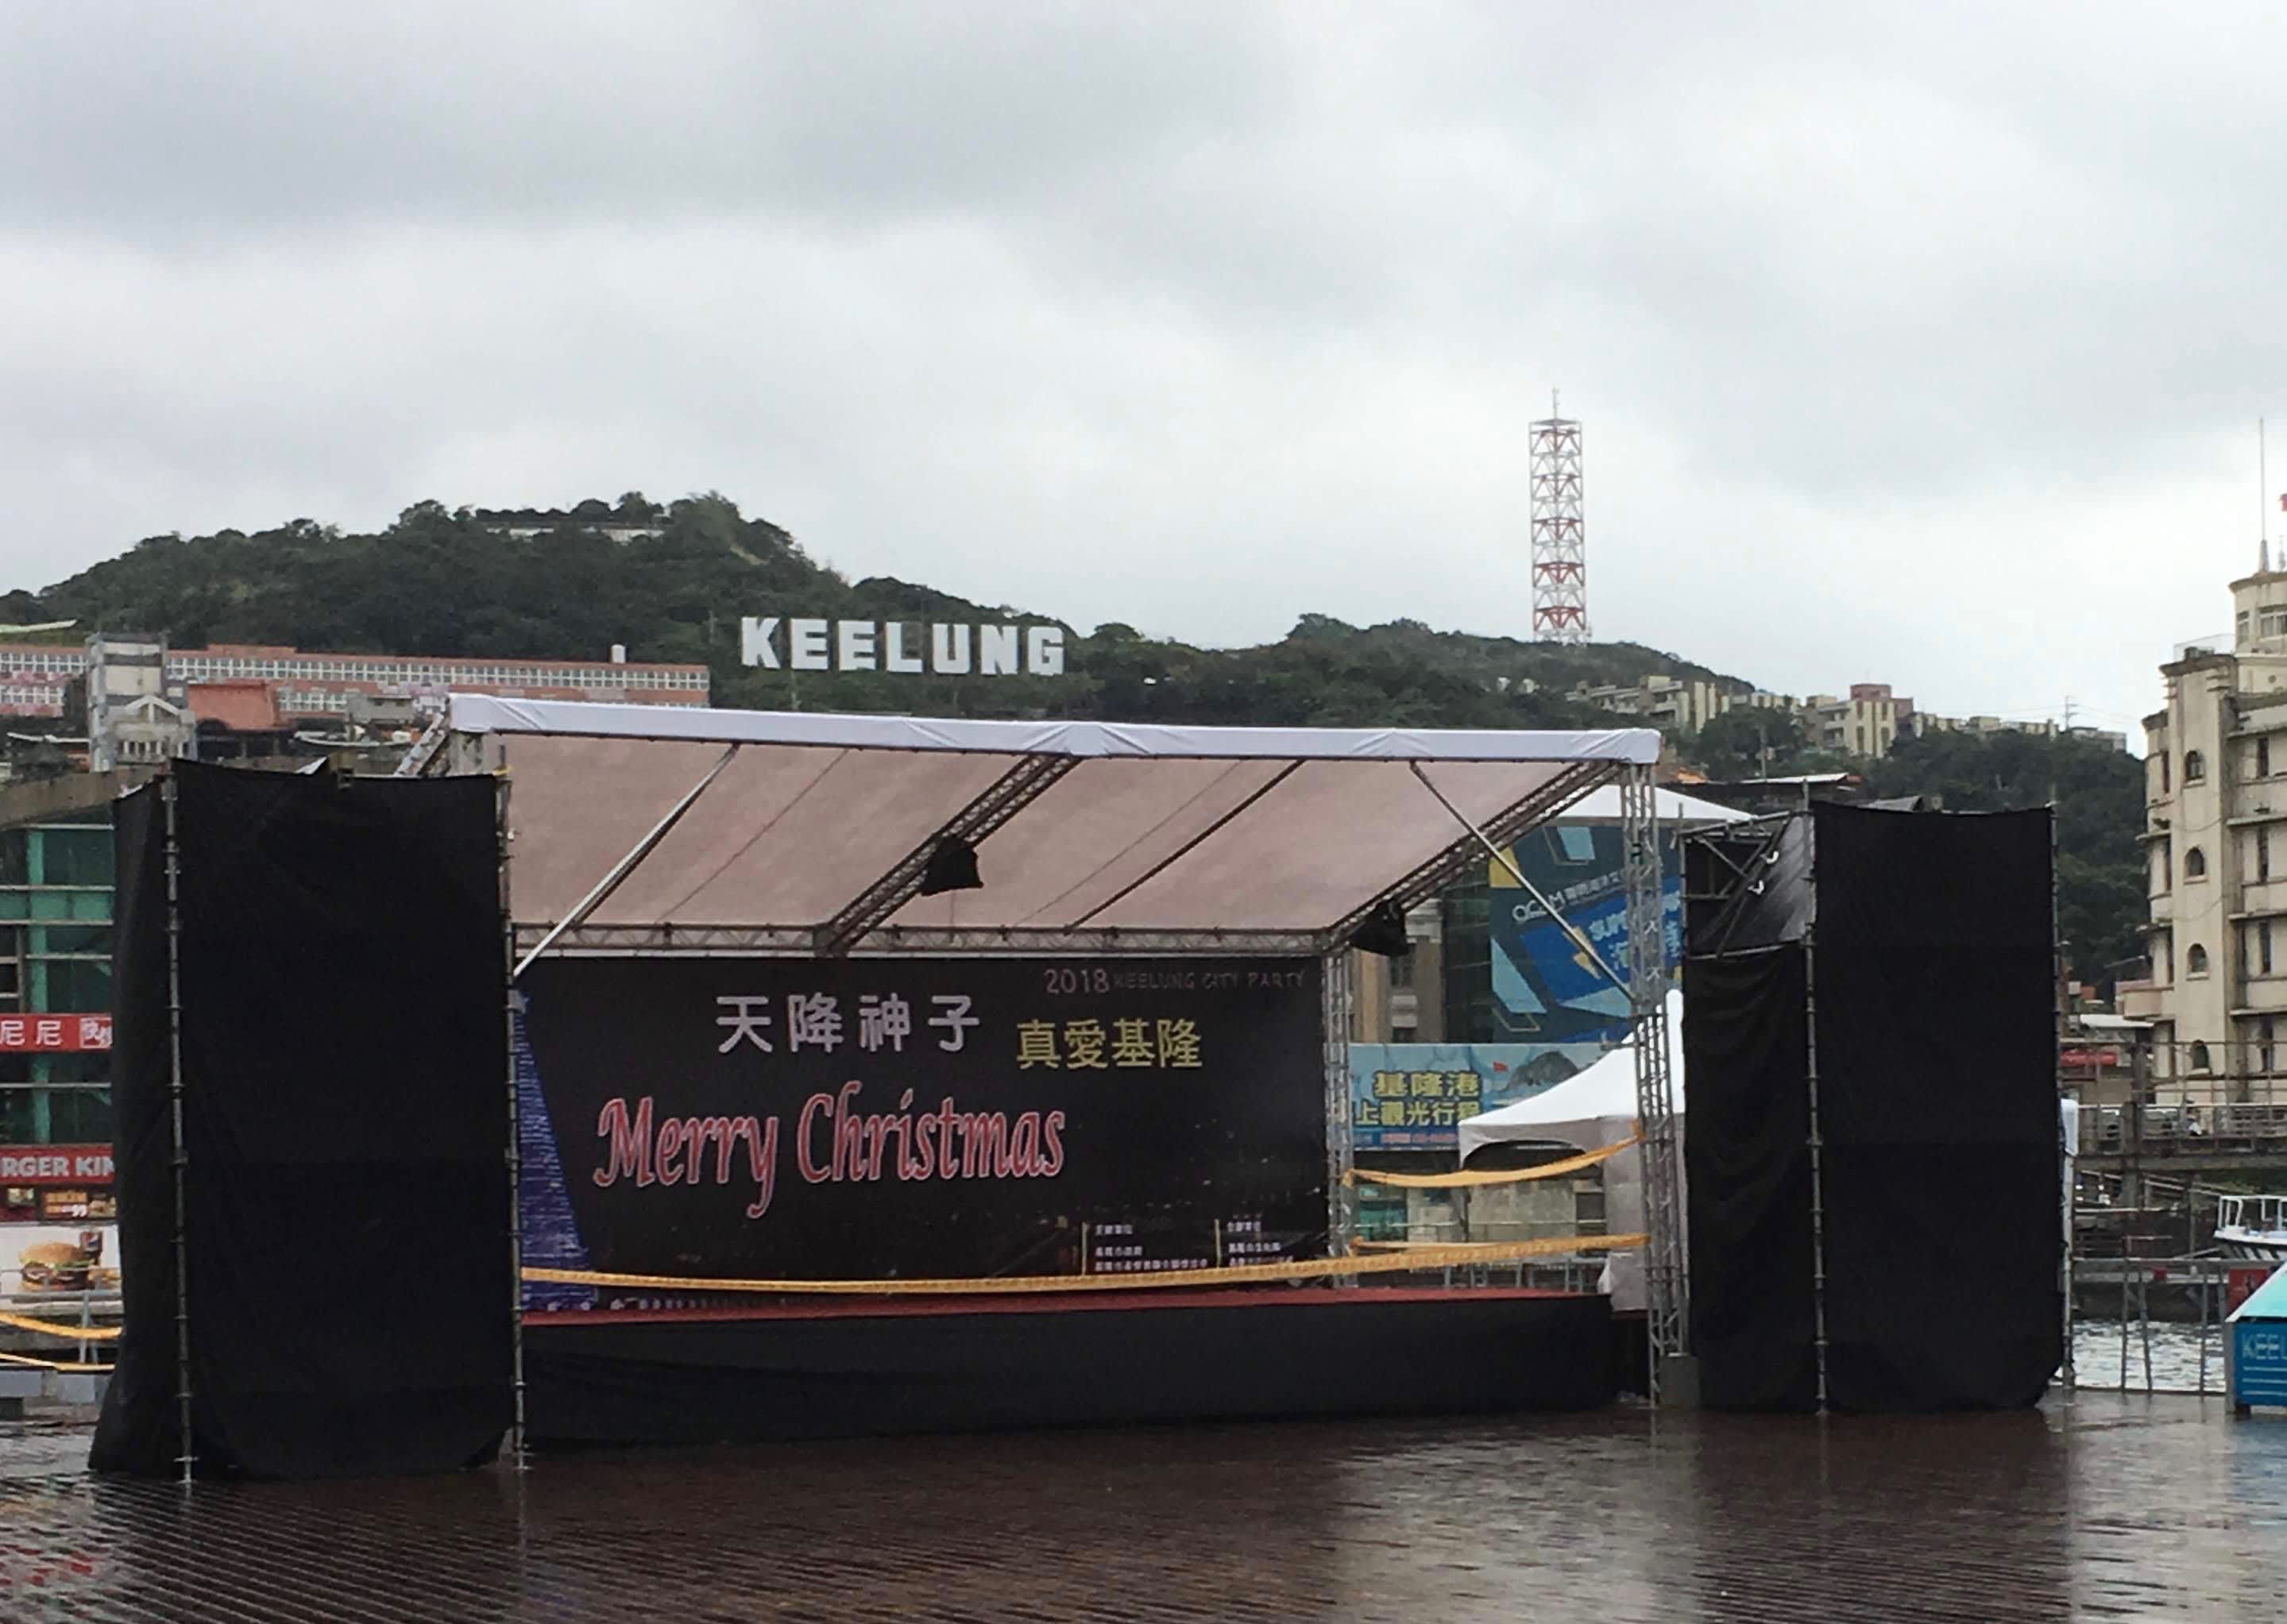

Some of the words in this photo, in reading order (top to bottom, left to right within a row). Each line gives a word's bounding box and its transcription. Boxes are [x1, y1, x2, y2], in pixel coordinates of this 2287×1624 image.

[741, 616, 1064, 676] KEELUNG
[1043, 968, 1110, 993] 2018
[1247, 968, 1305, 989] PARTY
[0, 1020, 63, 1046] 尼尼
[716, 992, 979, 1053] 天降神子
[1017, 1018, 1203, 1069] 真愛基隆
[1373, 1072, 1479, 1097] 基隆港
[1354, 1101, 1480, 1127] 上觀光行程
[593, 1096, 778, 1218] Merry
[797, 1080, 1066, 1183] Christmas
[1, 1155, 70, 1177] RGER
